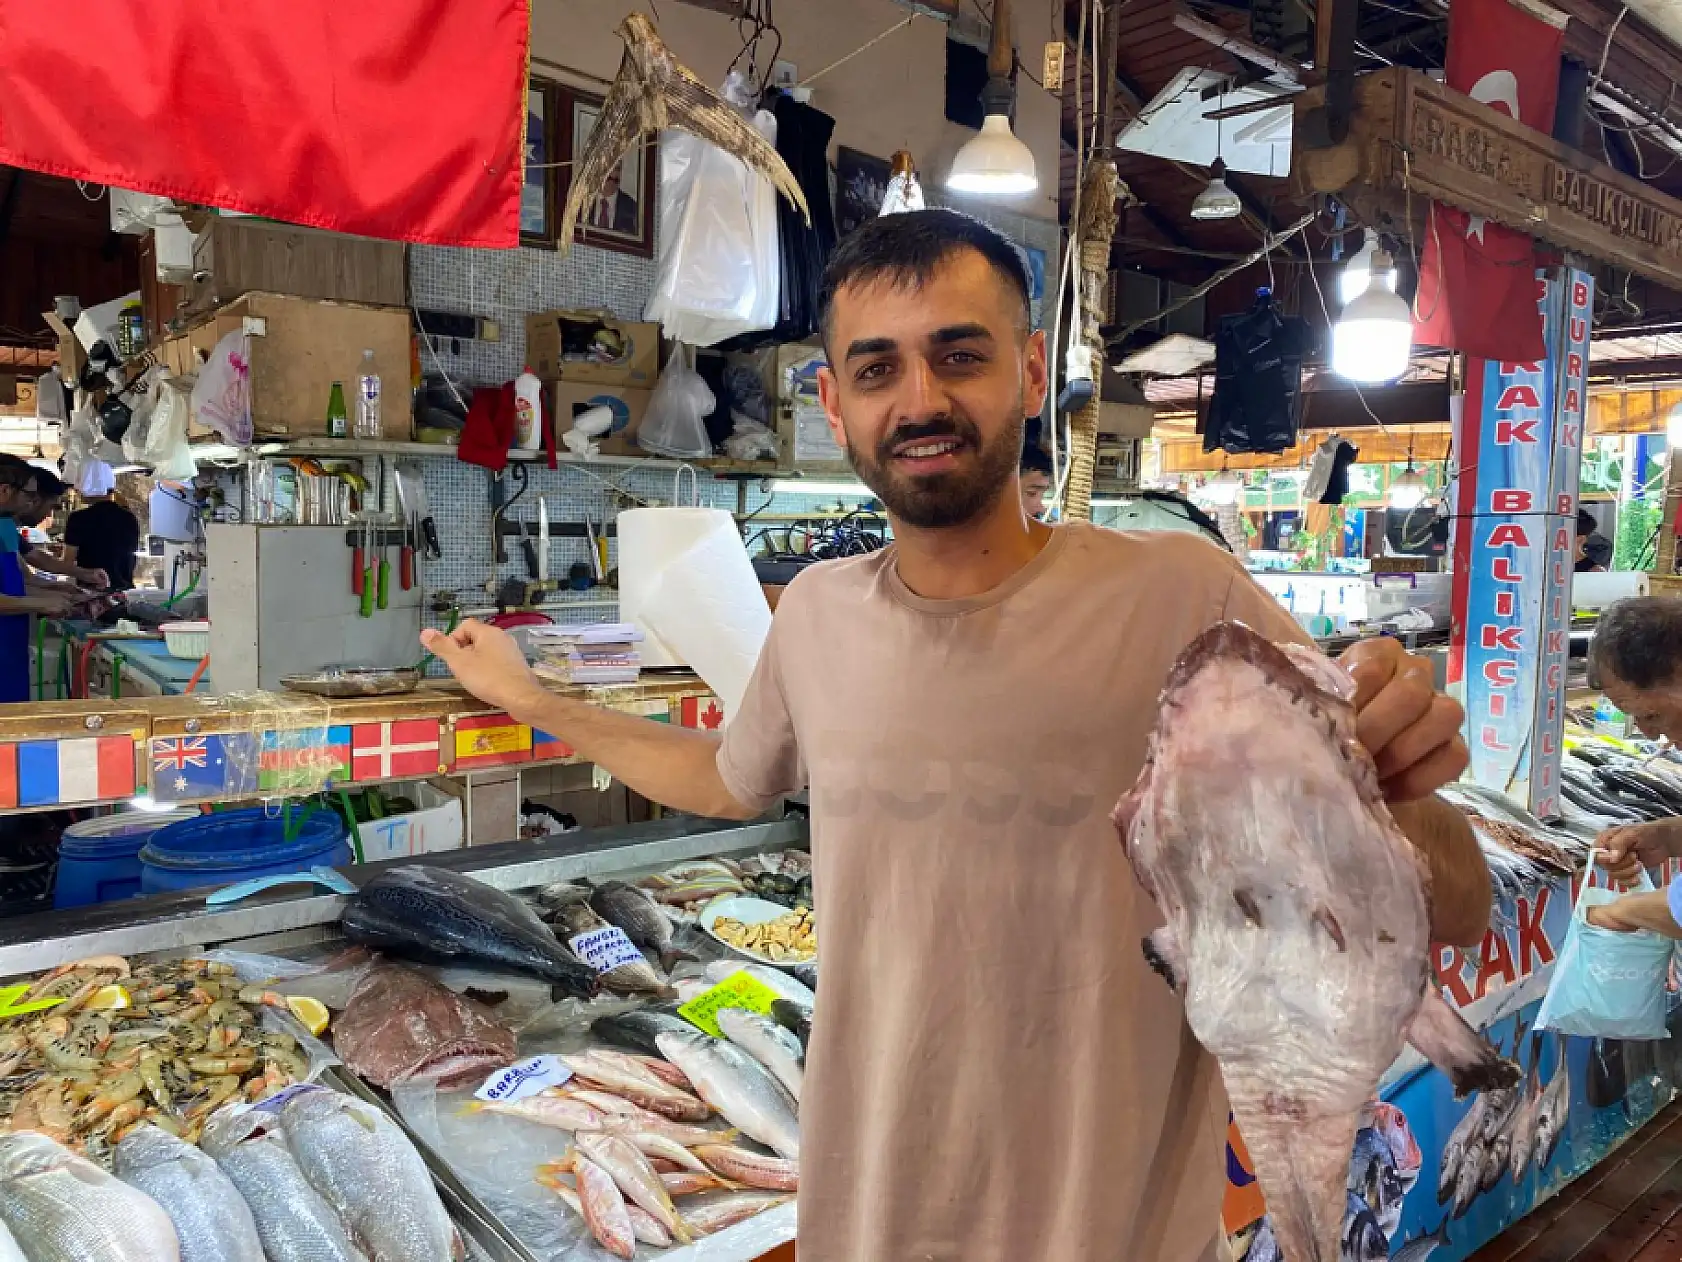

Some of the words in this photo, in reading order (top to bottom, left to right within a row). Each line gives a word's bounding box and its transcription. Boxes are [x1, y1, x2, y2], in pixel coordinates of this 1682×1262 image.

[1562, 281, 1588, 448] BURAK
[1480, 489, 1532, 777] BALIKÇIL
[1538, 494, 1573, 819] BALIKÇILIK
[1430, 886, 1555, 1009] RAK
